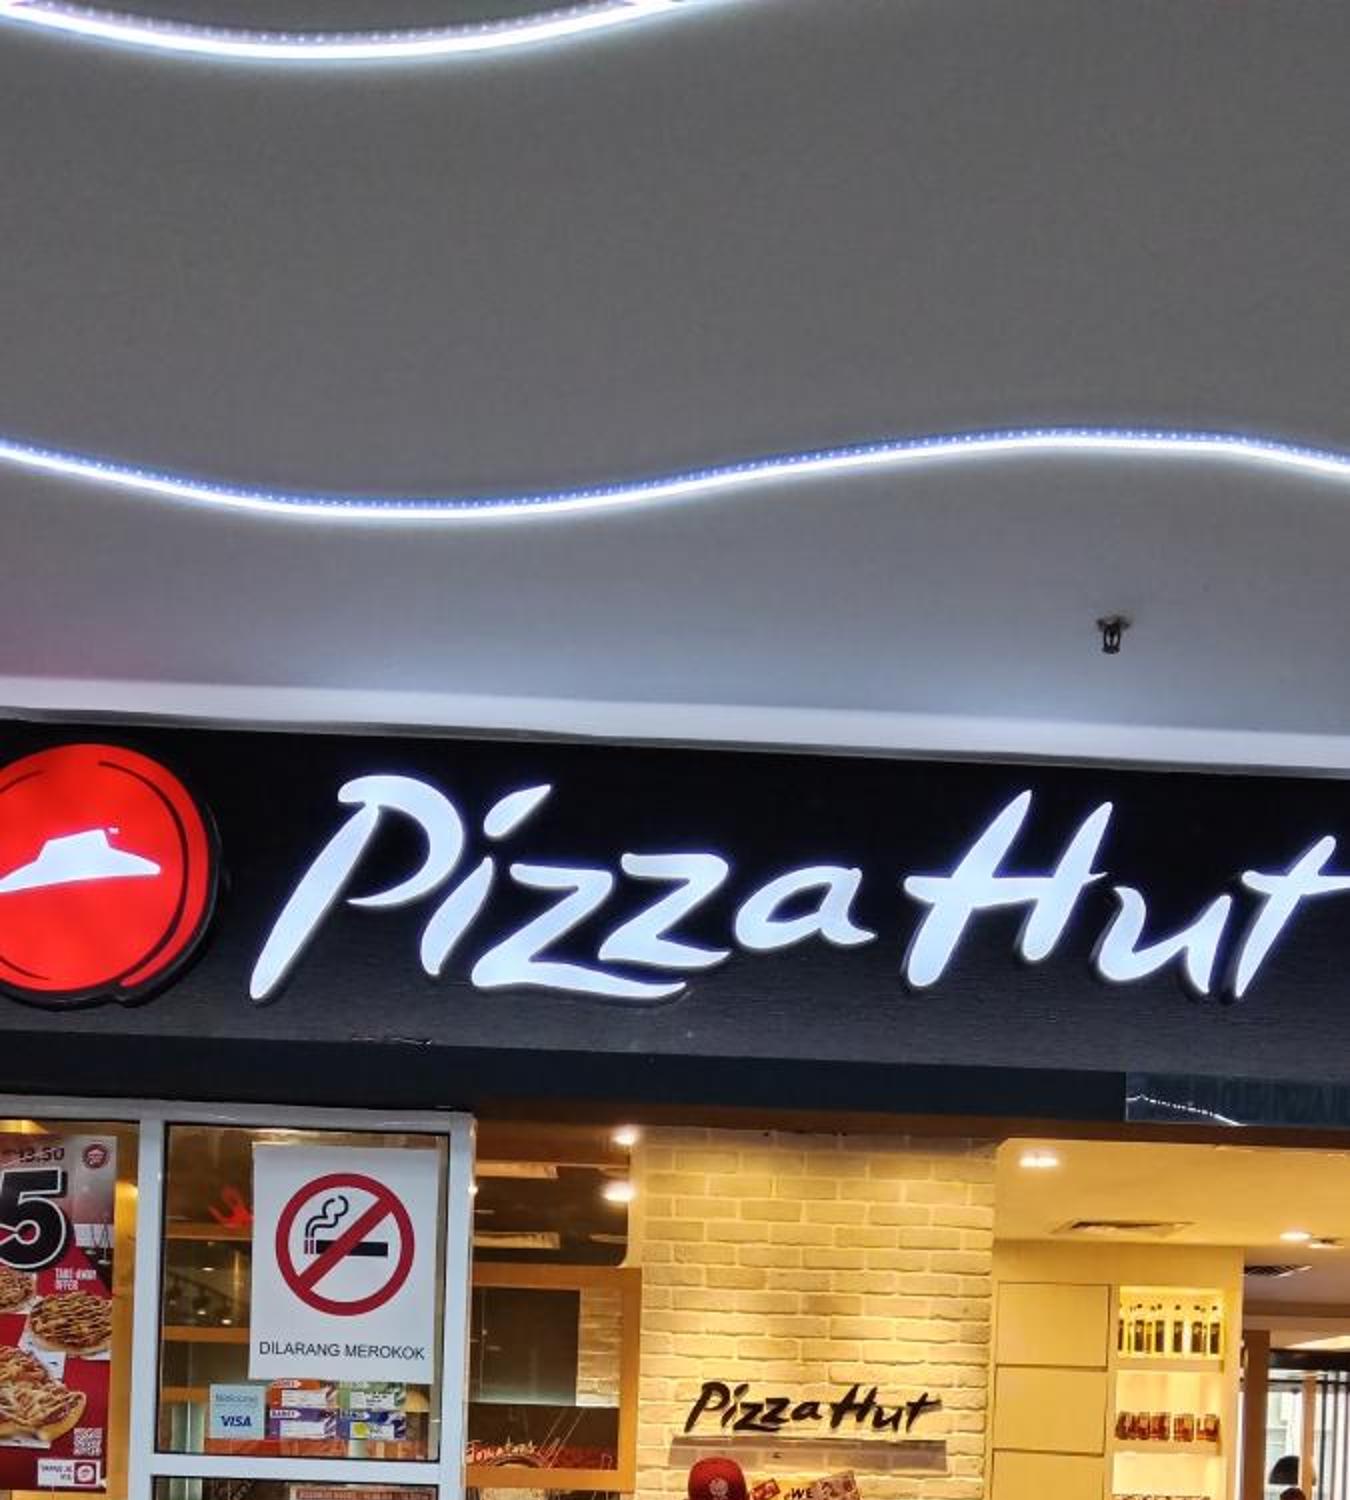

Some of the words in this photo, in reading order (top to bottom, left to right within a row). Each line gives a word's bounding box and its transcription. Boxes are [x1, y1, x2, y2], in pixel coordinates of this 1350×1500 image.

[250, 775, 876, 1001] Pizza
[904, 789, 1350, 999] Hut
[259, 1341, 341, 1357] DILARANG
[345, 1344, 425, 1361] MEROKOK
[221, 1415, 252, 1428] VISA
[684, 1381, 822, 1433] Pizza
[830, 1383, 942, 1432] Hut
